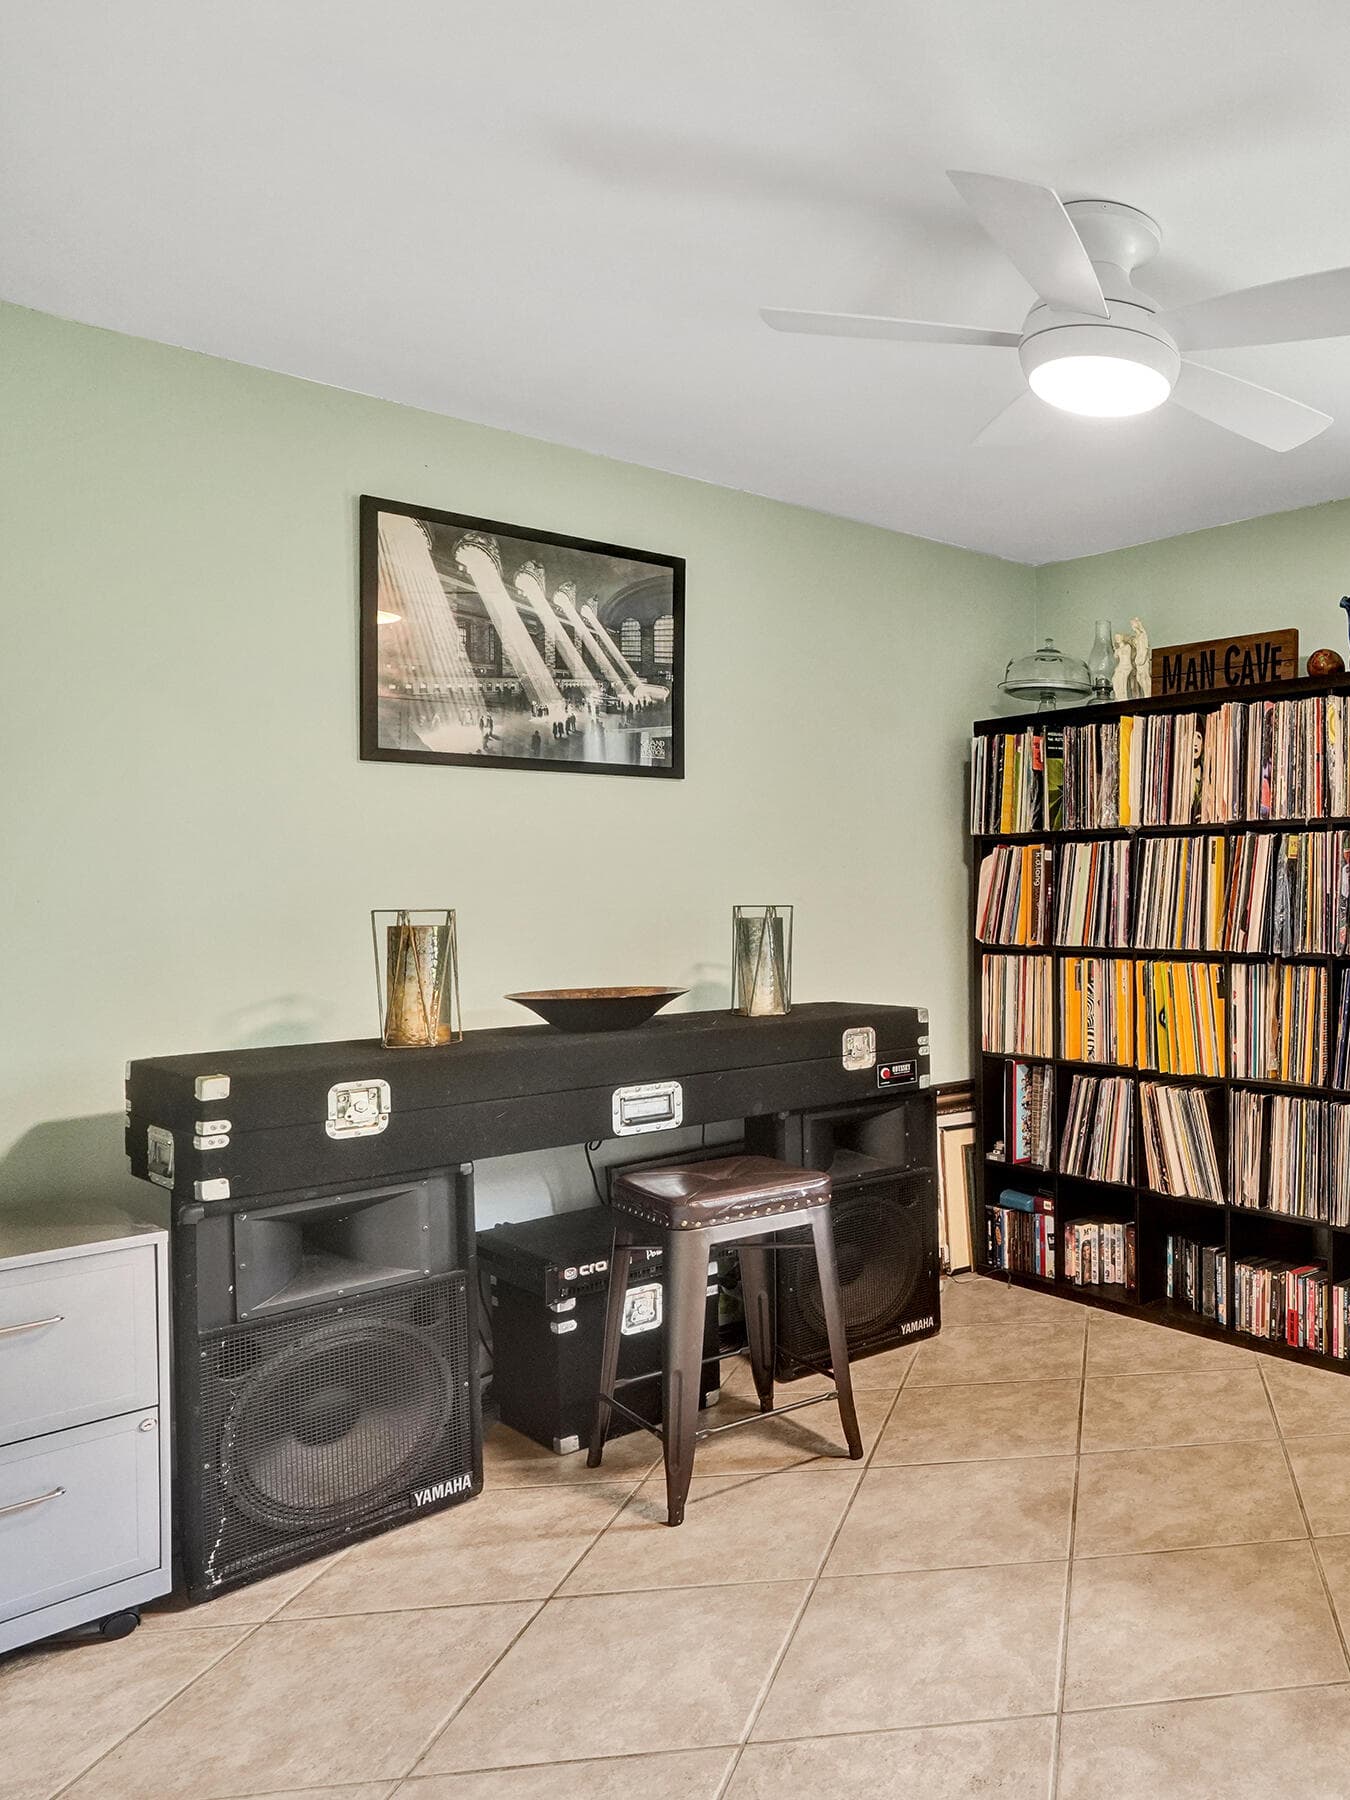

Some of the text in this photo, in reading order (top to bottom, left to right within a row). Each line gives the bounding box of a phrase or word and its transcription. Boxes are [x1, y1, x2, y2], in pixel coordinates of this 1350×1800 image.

[1162, 642, 1282, 694] MAN CAVE
[901, 1316, 934, 1335] YAMAHA
[414, 1474, 472, 1507] YAMAHA
